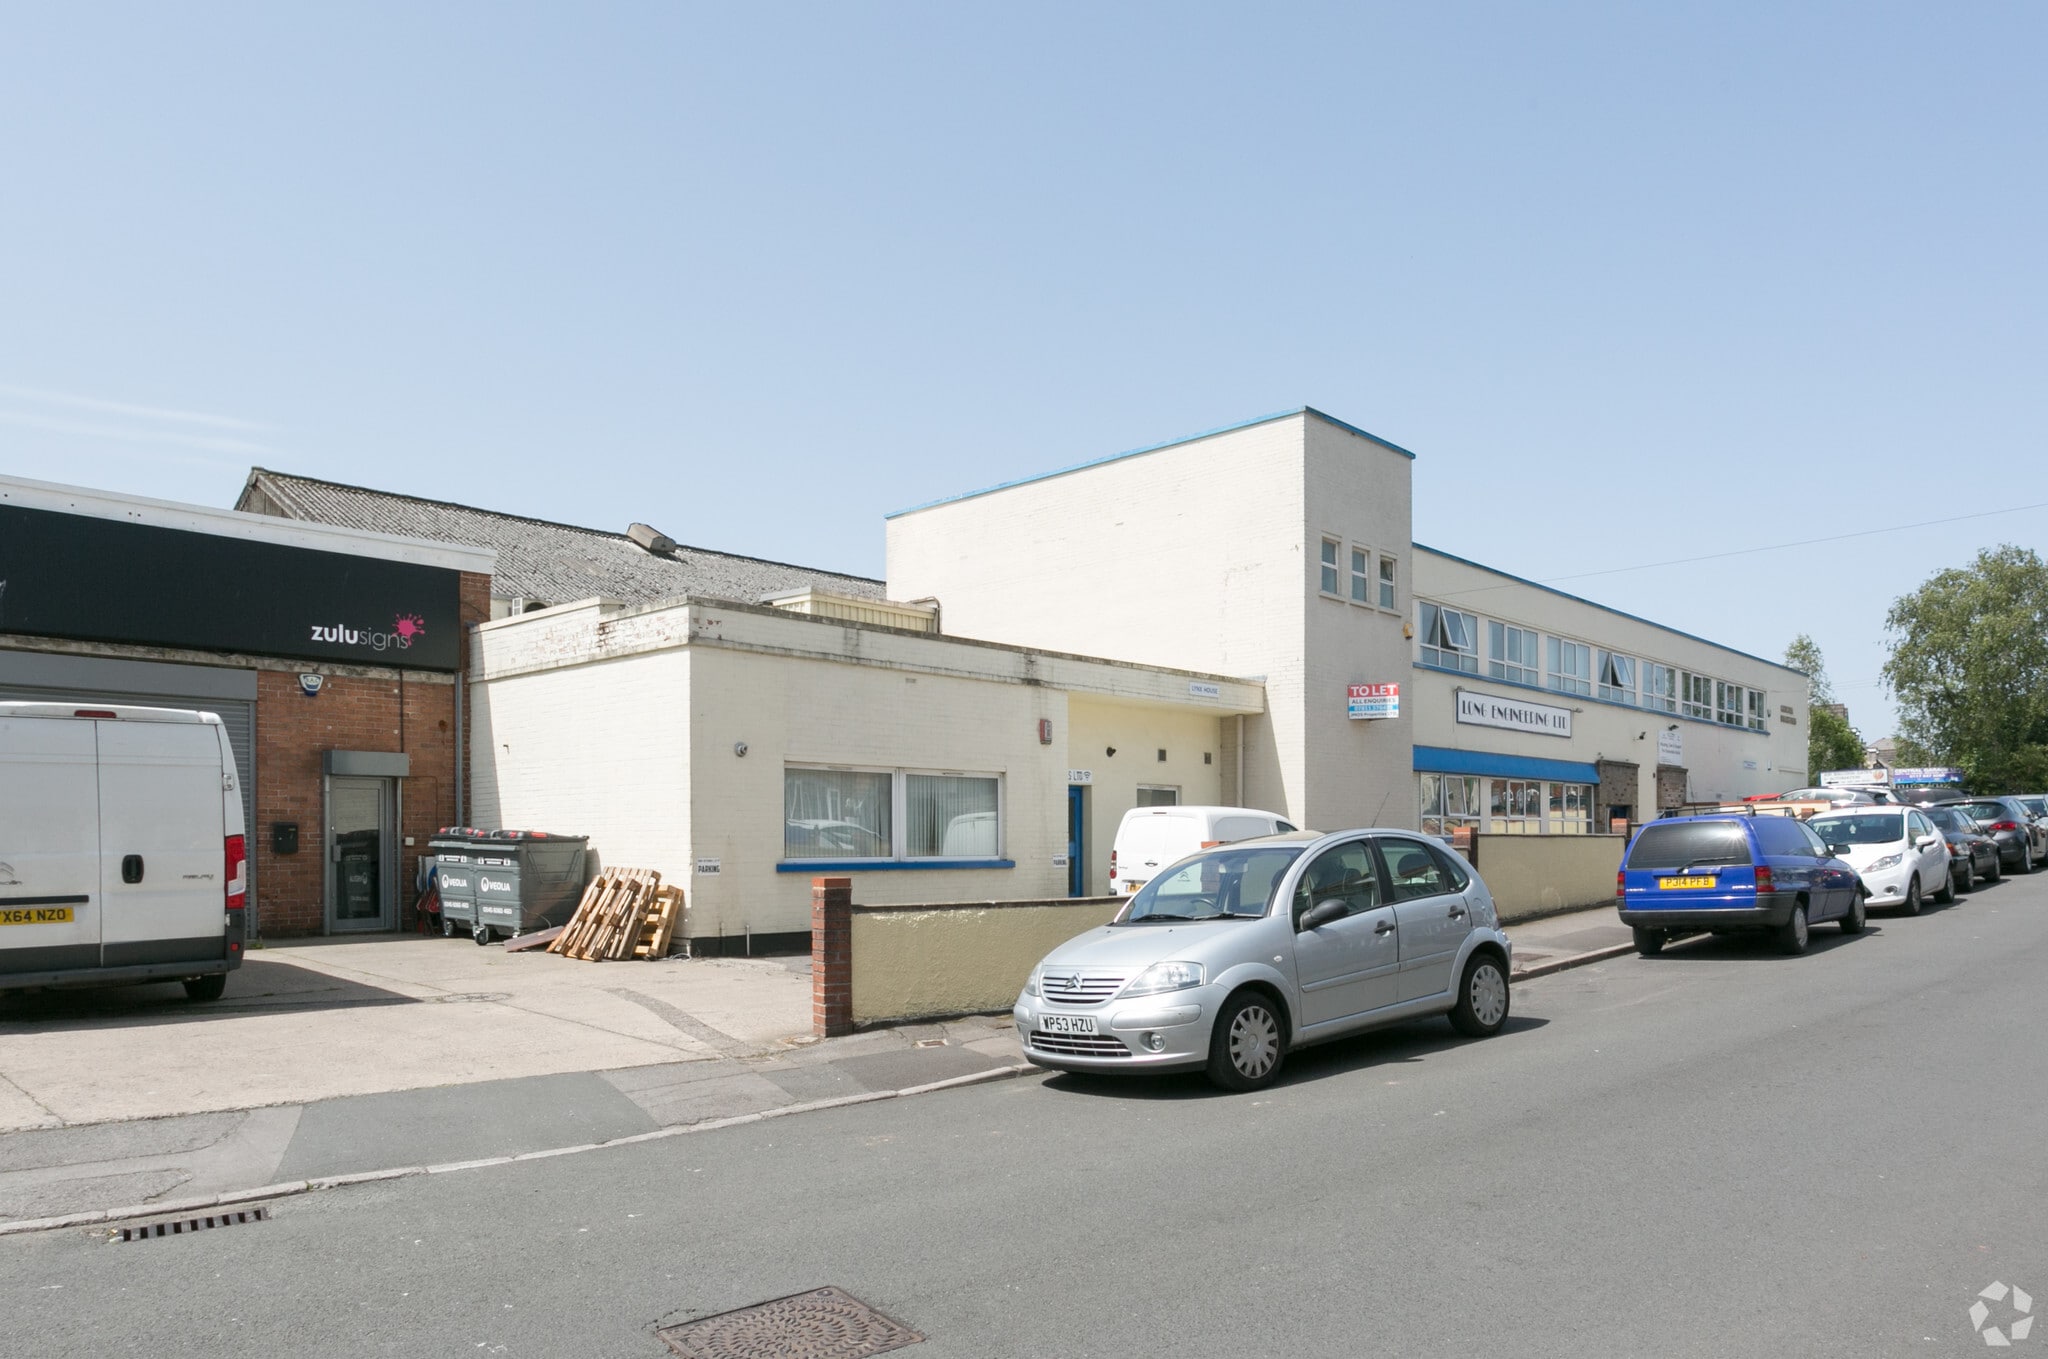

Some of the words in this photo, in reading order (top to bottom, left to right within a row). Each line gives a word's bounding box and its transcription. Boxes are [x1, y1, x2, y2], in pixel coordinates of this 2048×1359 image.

[1203, 687, 1218, 695] HOUSE
[1350, 686, 1370, 697] TO
[1372, 684, 1397, 696] LET
[1462, 700, 1488, 718] LONG
[1491, 704, 1549, 728] ENGINEERING
[1553, 714, 1567, 730] LTD
[697, 865, 720, 874] PARKING
[448, 878, 468, 887] VEOLIA
[489, 882, 511, 891] VEOLIA
[36, 908, 67, 922] NZO
[1042, 1016, 1070, 1031] WP53
[1071, 1018, 1094, 1033] HZU
